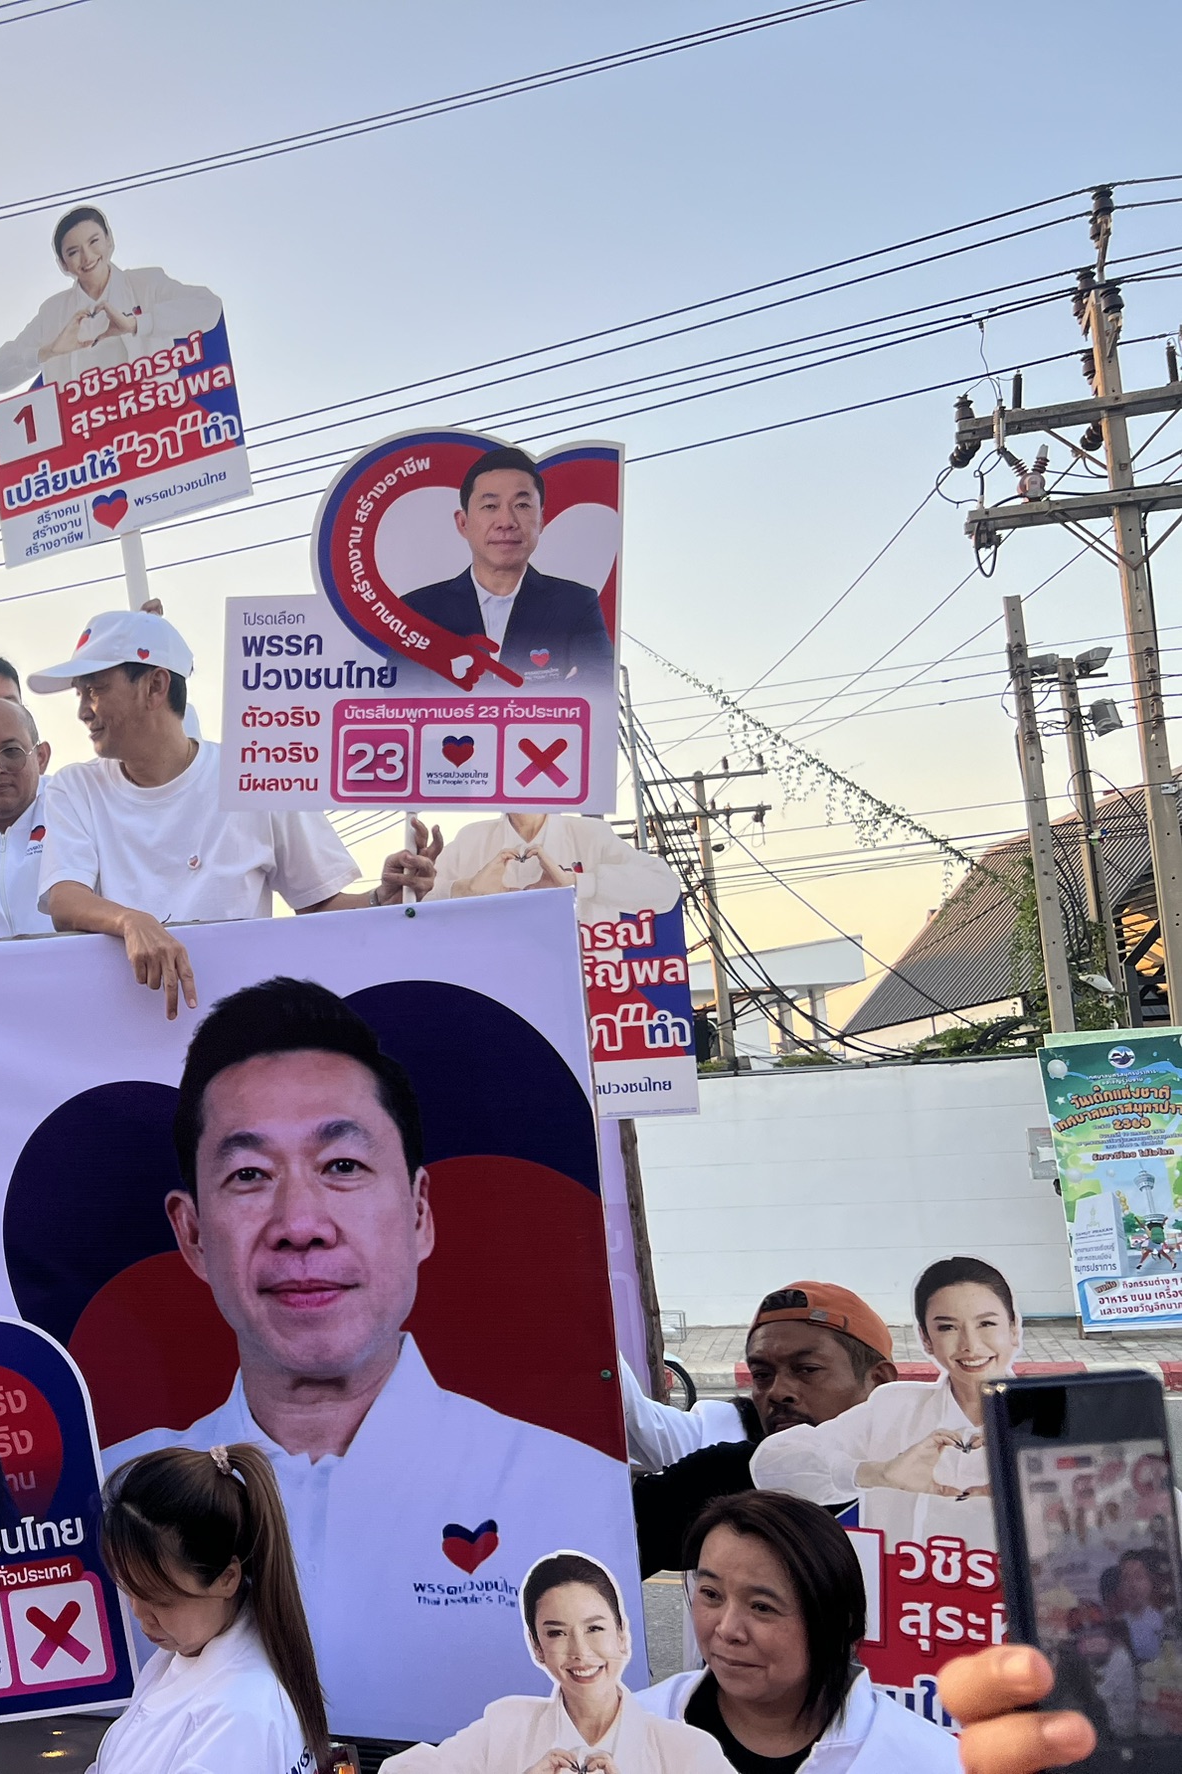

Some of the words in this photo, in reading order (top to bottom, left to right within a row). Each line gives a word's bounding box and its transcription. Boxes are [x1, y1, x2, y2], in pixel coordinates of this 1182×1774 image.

[66, 333, 202, 403] วชิราภรณ์
[71, 366, 232, 439] สุระหิรัญพล
[13, 404, 37, 445] 1
[134, 470, 227, 507] พรรคปวงชนไทย
[355, 456, 430, 523] สร้างอาชีพ
[36, 503, 80, 525] สร้างคน
[32, 516, 82, 540] สร้างงาน
[25, 531, 84, 557] สร้างอาชีพ
[348, 526, 376, 602] สร้างงาน
[243, 612, 305, 626] โปรดเลือก
[371, 601, 430, 650] สร้างคน
[242, 634, 322, 657] พรรค
[242, 661, 397, 691] ปวงชนไทย
[241, 706, 321, 728] ตัวจริง
[344, 704, 474, 724] บัตรสีชมพูกาเบอร์
[477, 706, 500, 719] 23
[503, 701, 581, 719] ทั่วประเทศ
[241, 741, 319, 764] ทำจริง
[346, 742, 405, 782] 23
[239, 774, 319, 793] มีผลงาน
[595, 1077, 672, 1095] ปวงชนไทย
[1070, 1085, 1171, 1109] วันเด็กแห่งชาติ
[1053, 1101, 1182, 1132] เทศบาลนครสมุทรปรา
[1122, 1277, 1170, 1289] กิจกรรมต่าง
[1099, 1295, 1128, 1305] อาหาร
[1130, 1293, 1152, 1302] ขนม
